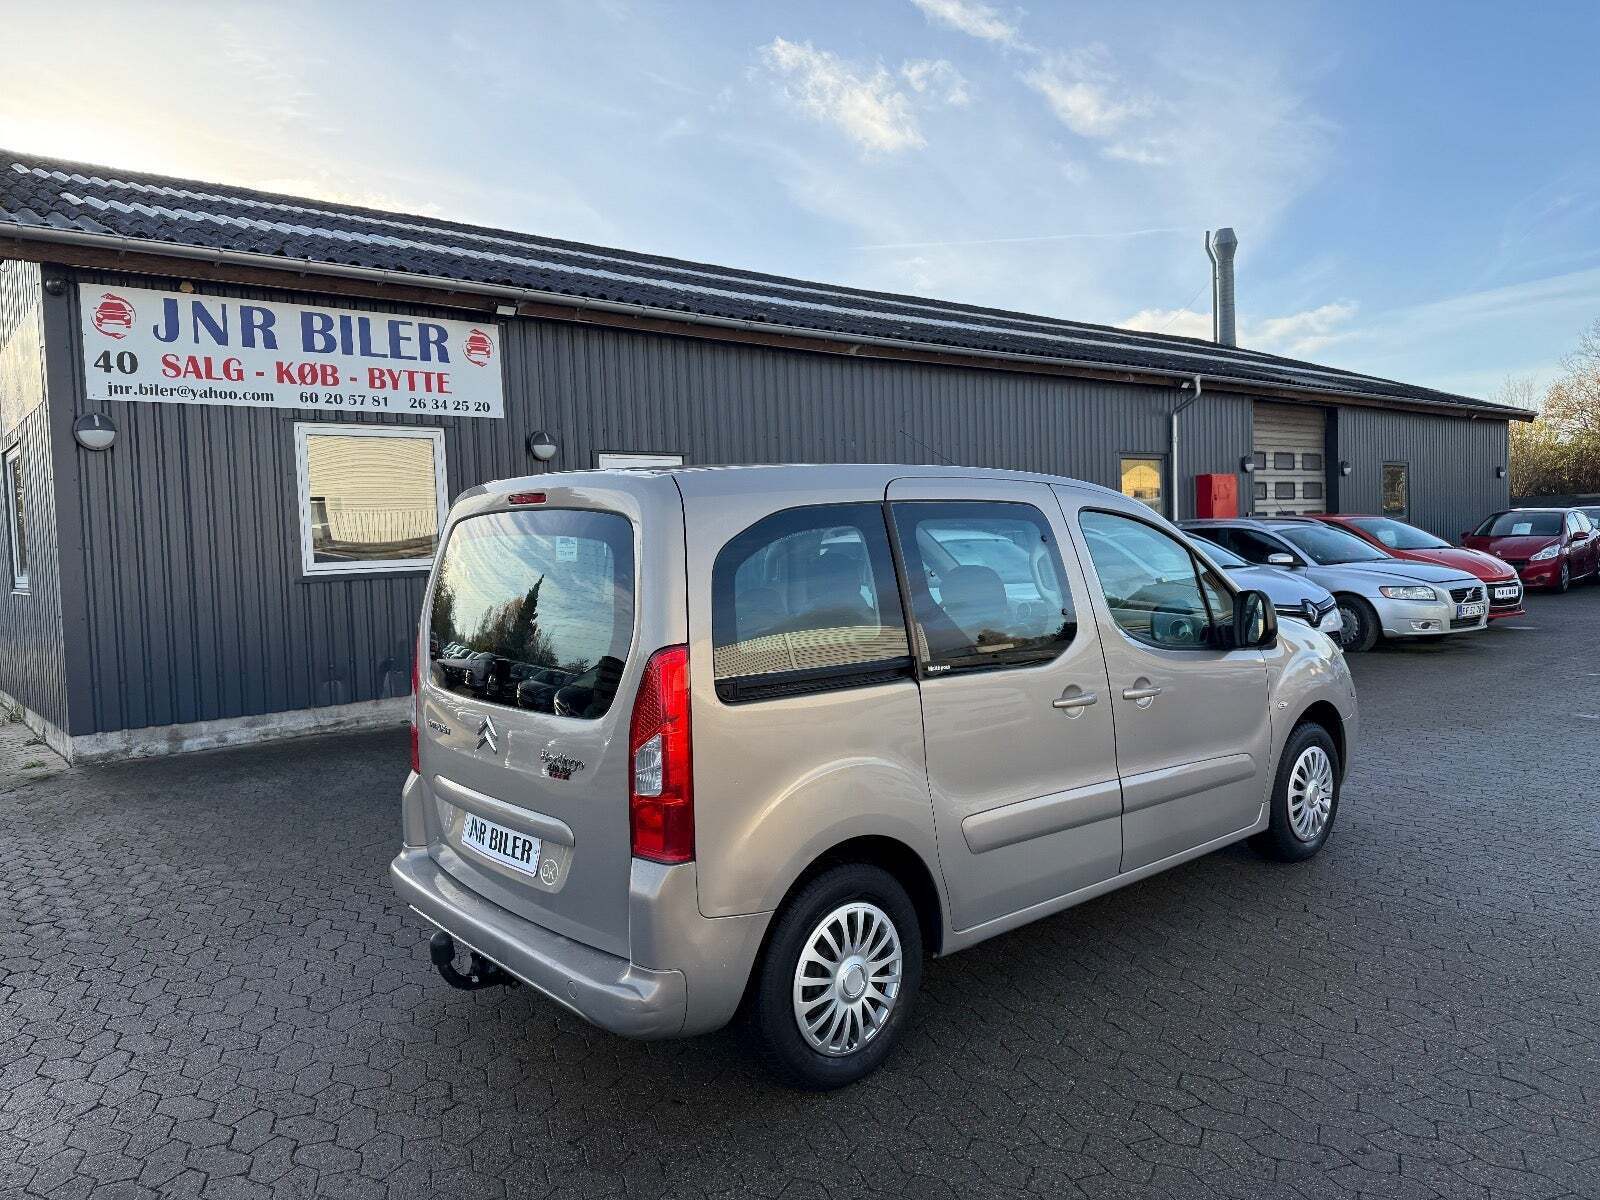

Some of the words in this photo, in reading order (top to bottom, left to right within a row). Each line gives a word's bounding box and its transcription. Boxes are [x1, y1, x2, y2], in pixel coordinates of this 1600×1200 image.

[152, 297, 279, 350] JNR
[300, 310, 451, 364] BILER
[93, 350, 139, 375] 40
[161, 353, 245, 382] SALG
[275, 360, 340, 386] KØB
[367, 367, 453, 395] BYTTE
[107, 381, 275, 402] jnr.biler@yahoo.com
[299, 391, 319, 404] 60
[324, 393, 344, 405] 20
[348, 394, 366, 407] 57
[371, 395, 389, 408] 81
[409, 397, 427, 410] 26
[431, 398, 448, 411] 34
[452, 400, 470, 412] 25
[474, 401, 491, 413] 20
[488, 826, 533, 865] BILER
